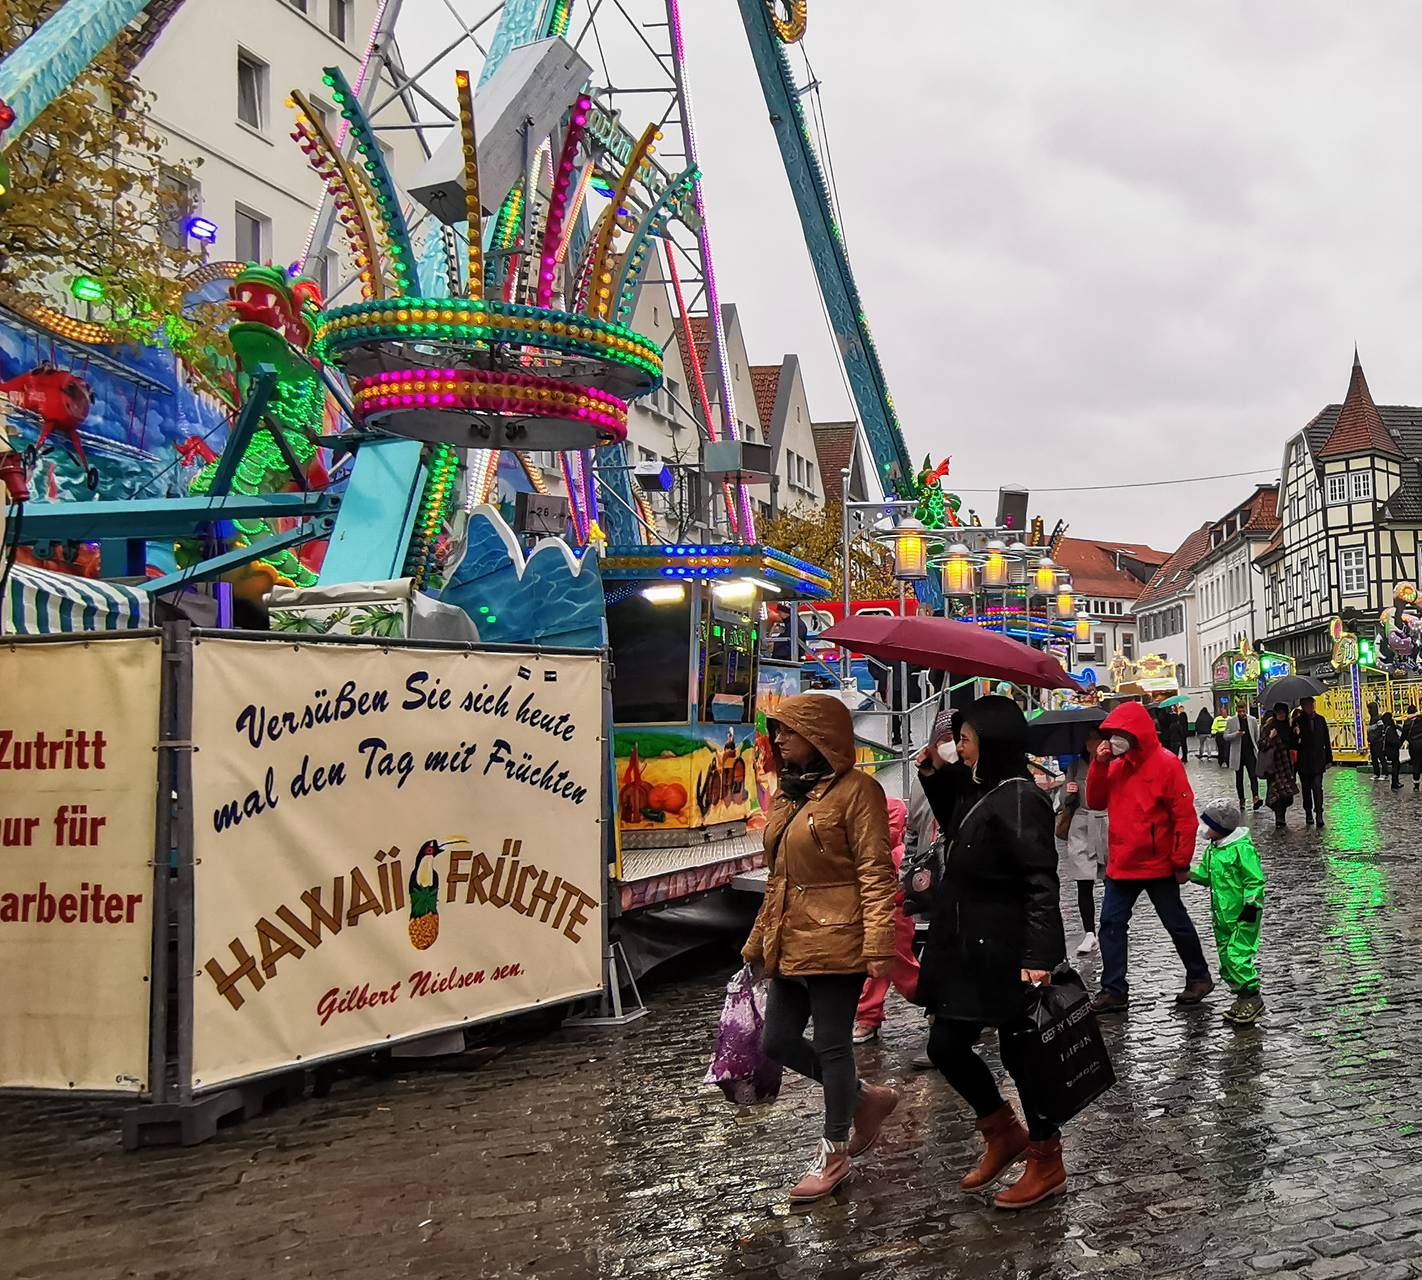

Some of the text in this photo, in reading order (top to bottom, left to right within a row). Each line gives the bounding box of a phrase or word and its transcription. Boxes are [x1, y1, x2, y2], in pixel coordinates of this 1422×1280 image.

[235, 671, 576, 749] Versüßen Sie sich heute
[0, 728, 107, 770] Zutritt
[213, 737, 589, 833] mal den Tag mit Früchten
[0, 804, 107, 847] ur für
[446, 838, 599, 945] FRÜCHTE
[316, 961, 526, 1026] Gilbert Nielsen sen.
